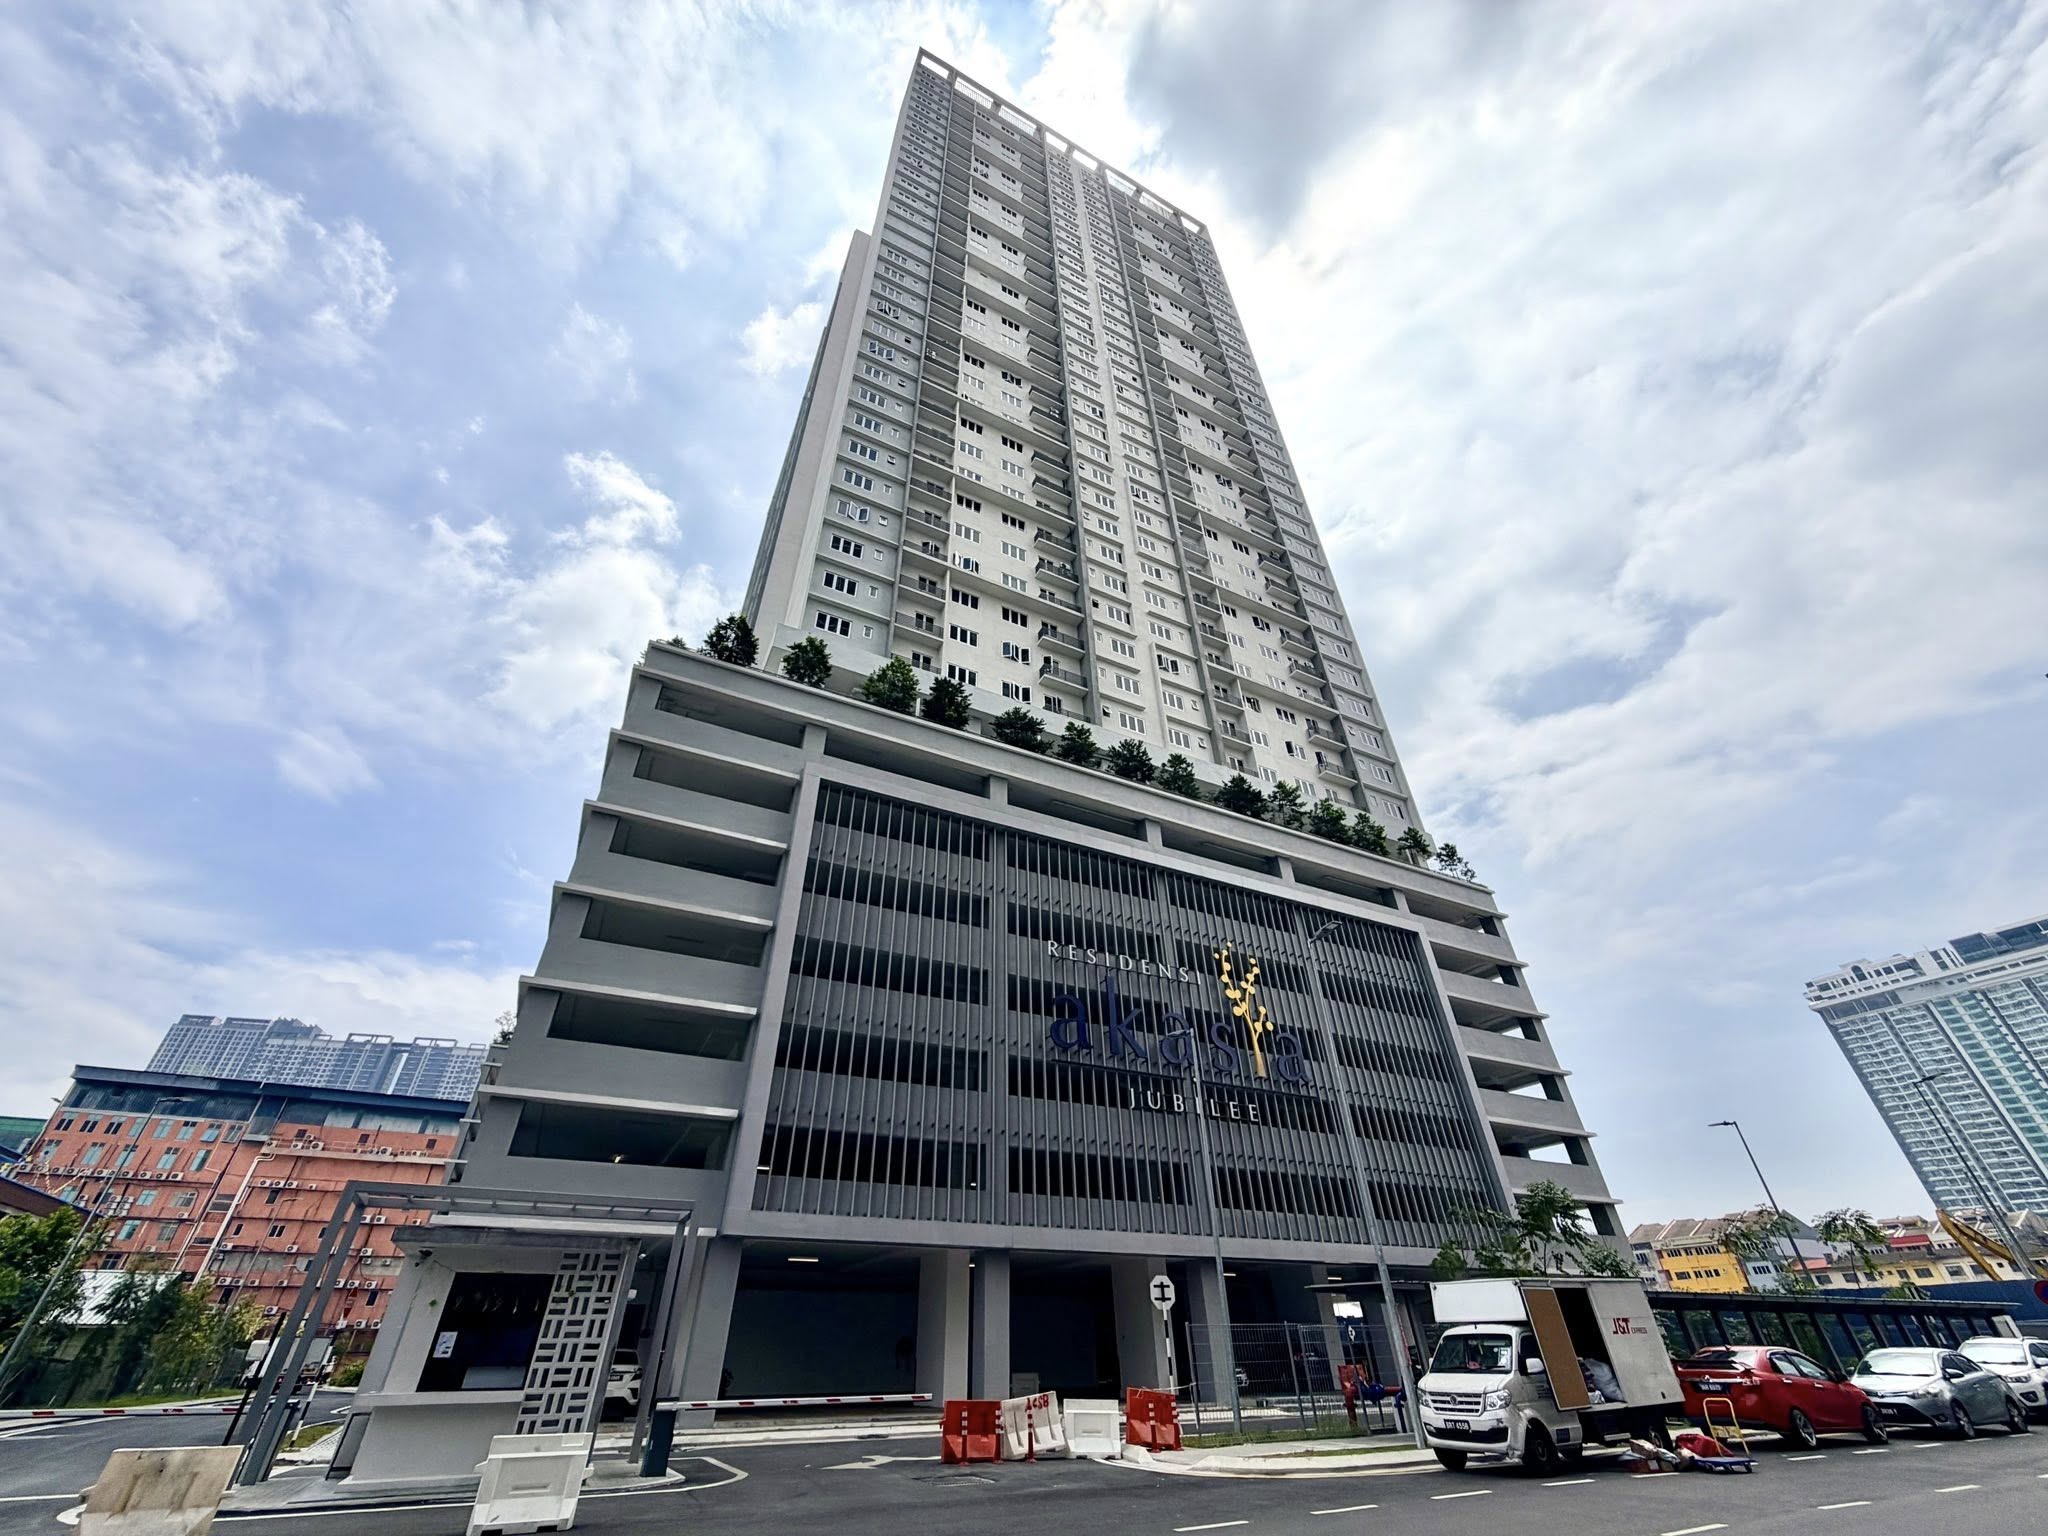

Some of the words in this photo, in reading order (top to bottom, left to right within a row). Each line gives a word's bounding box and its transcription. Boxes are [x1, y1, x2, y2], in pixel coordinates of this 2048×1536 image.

[1047, 940, 1201, 985] RESIDENSI
[1129, 1087, 1260, 1123] JUBILEE
[1612, 1317, 1631, 1335] J&T
